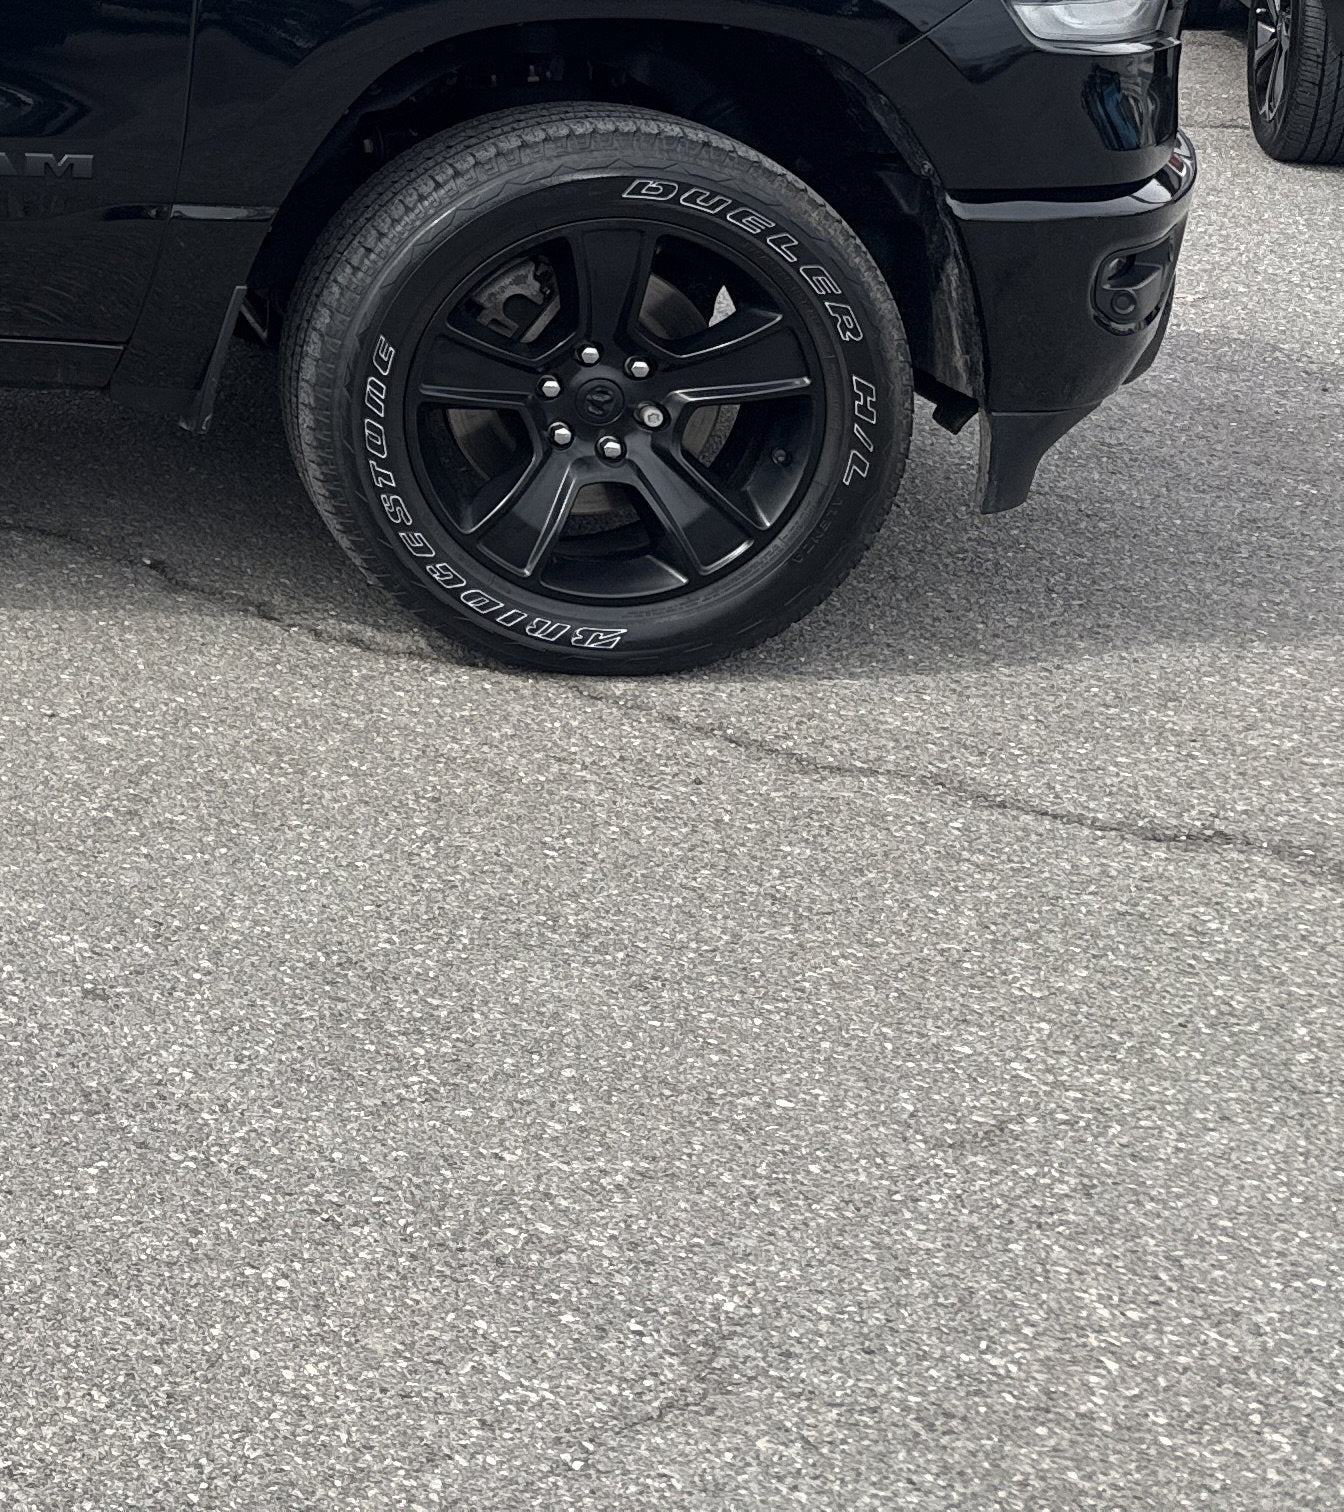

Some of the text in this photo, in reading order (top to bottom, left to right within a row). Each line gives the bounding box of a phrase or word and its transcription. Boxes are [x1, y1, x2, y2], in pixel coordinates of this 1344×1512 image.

[622, 178, 876, 486] DUELER H/L
[363, 335, 629, 649] BRIDGESTONE
